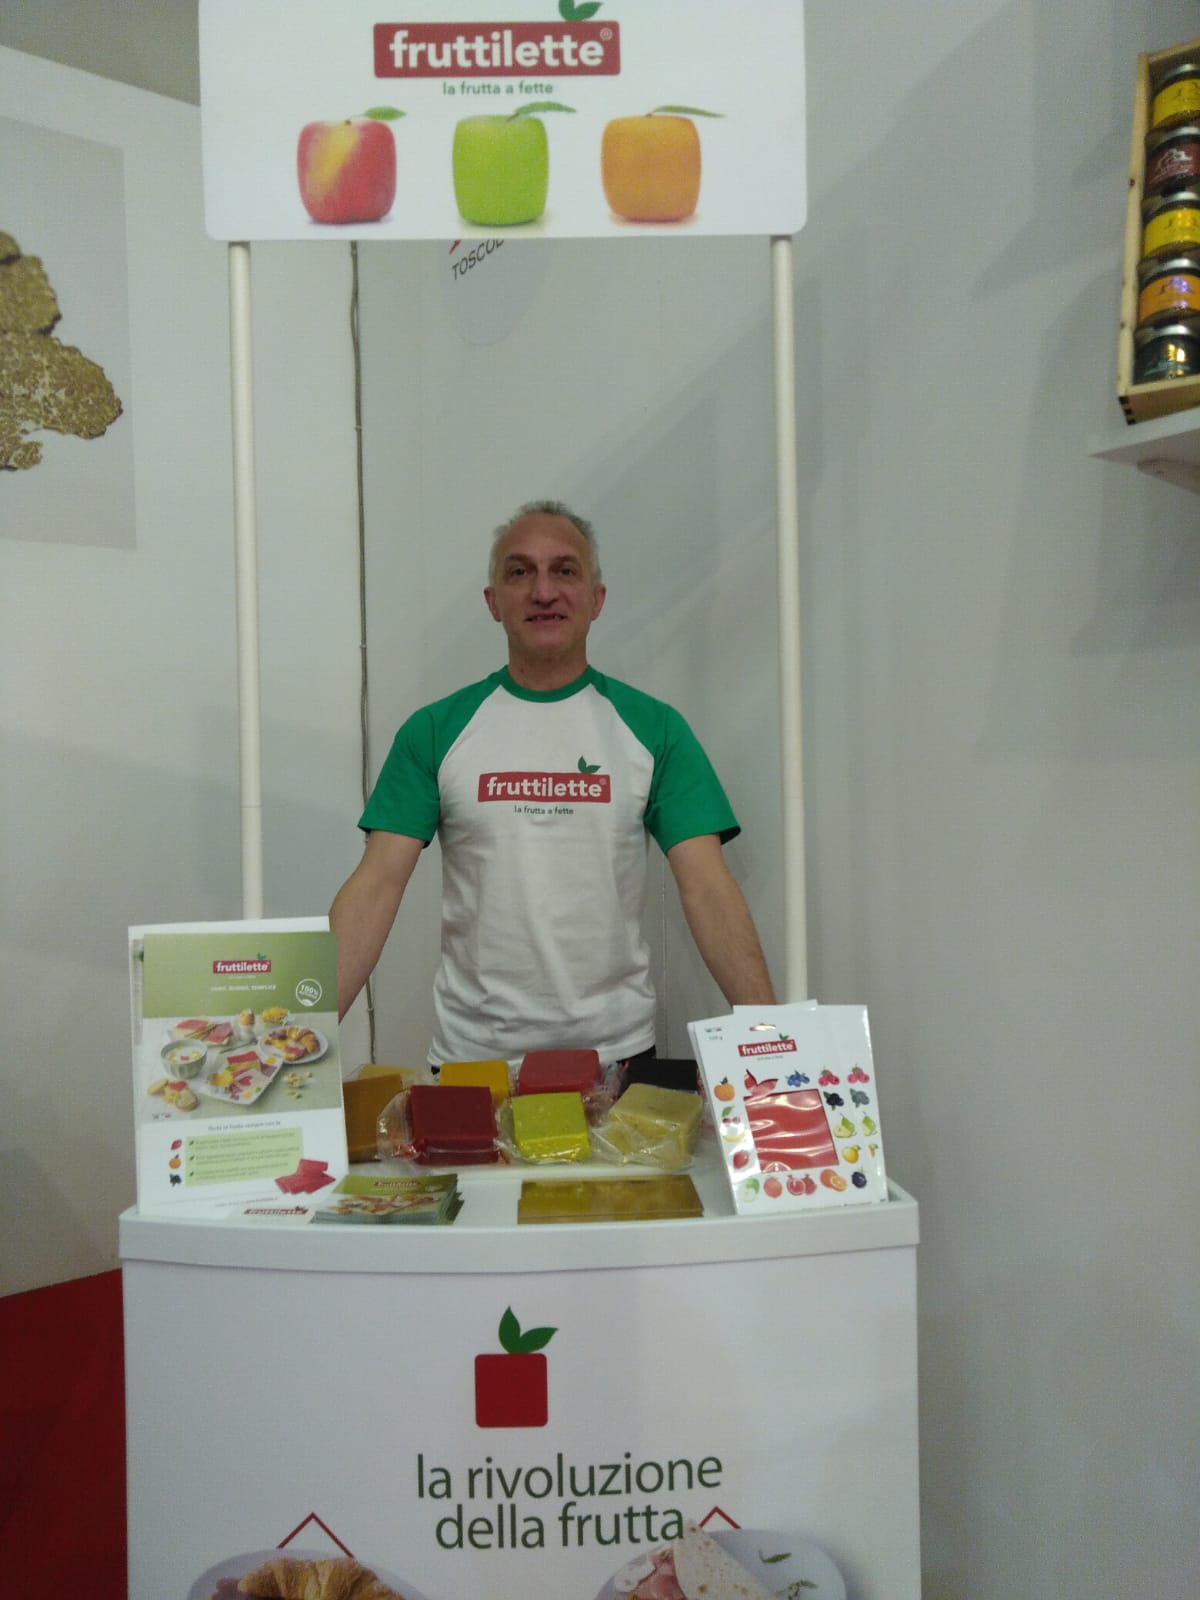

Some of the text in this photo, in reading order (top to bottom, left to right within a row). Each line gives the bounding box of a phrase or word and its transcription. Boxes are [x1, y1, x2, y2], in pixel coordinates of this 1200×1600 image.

[443, 80, 554, 95] la frutta a fette
[514, 805, 522, 813] la
[524, 805, 546, 815] frutta
[554, 806, 574, 815] fette
[417, 1452, 723, 1499] la rivoluzione
[435, 1501, 684, 1549] della frutta
